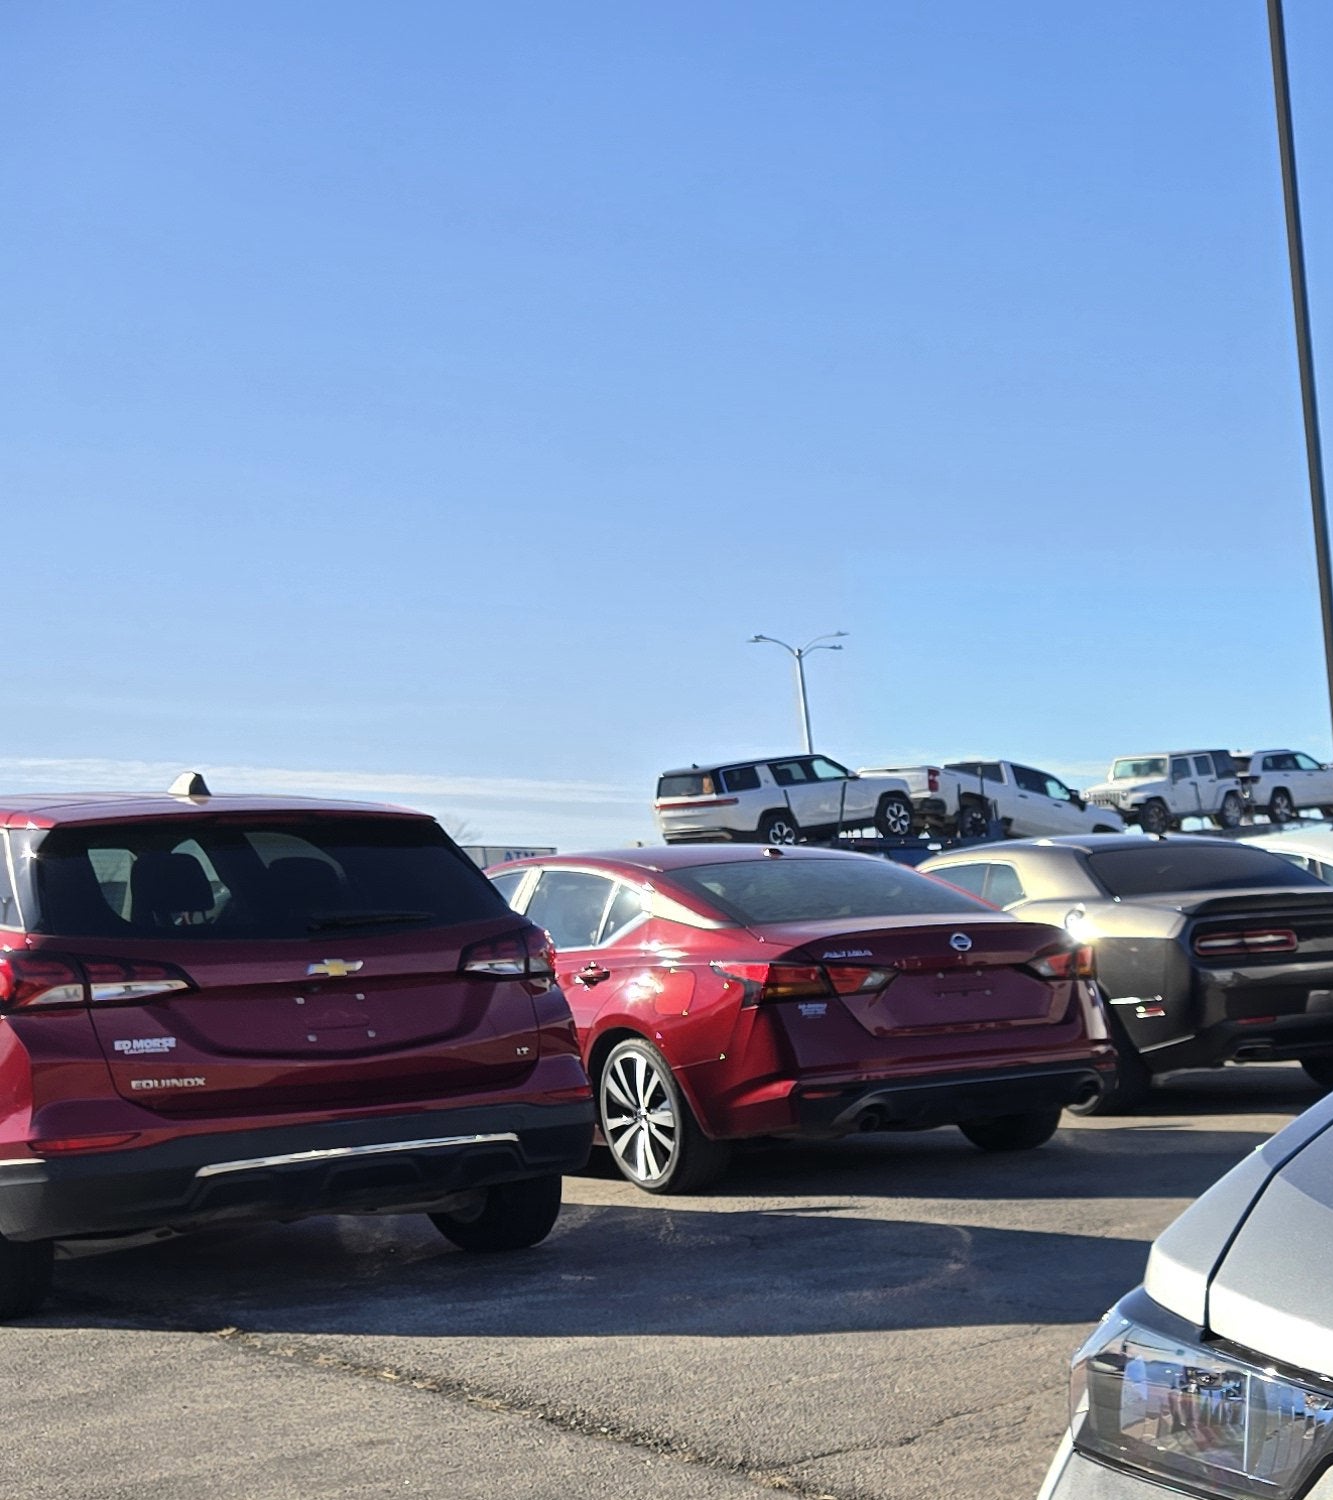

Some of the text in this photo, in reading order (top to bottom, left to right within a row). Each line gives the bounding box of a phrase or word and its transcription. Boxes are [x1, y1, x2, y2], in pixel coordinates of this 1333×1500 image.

[114, 1037, 176, 1051] ED MORSE
[131, 1077, 206, 1090] EQUINOX
